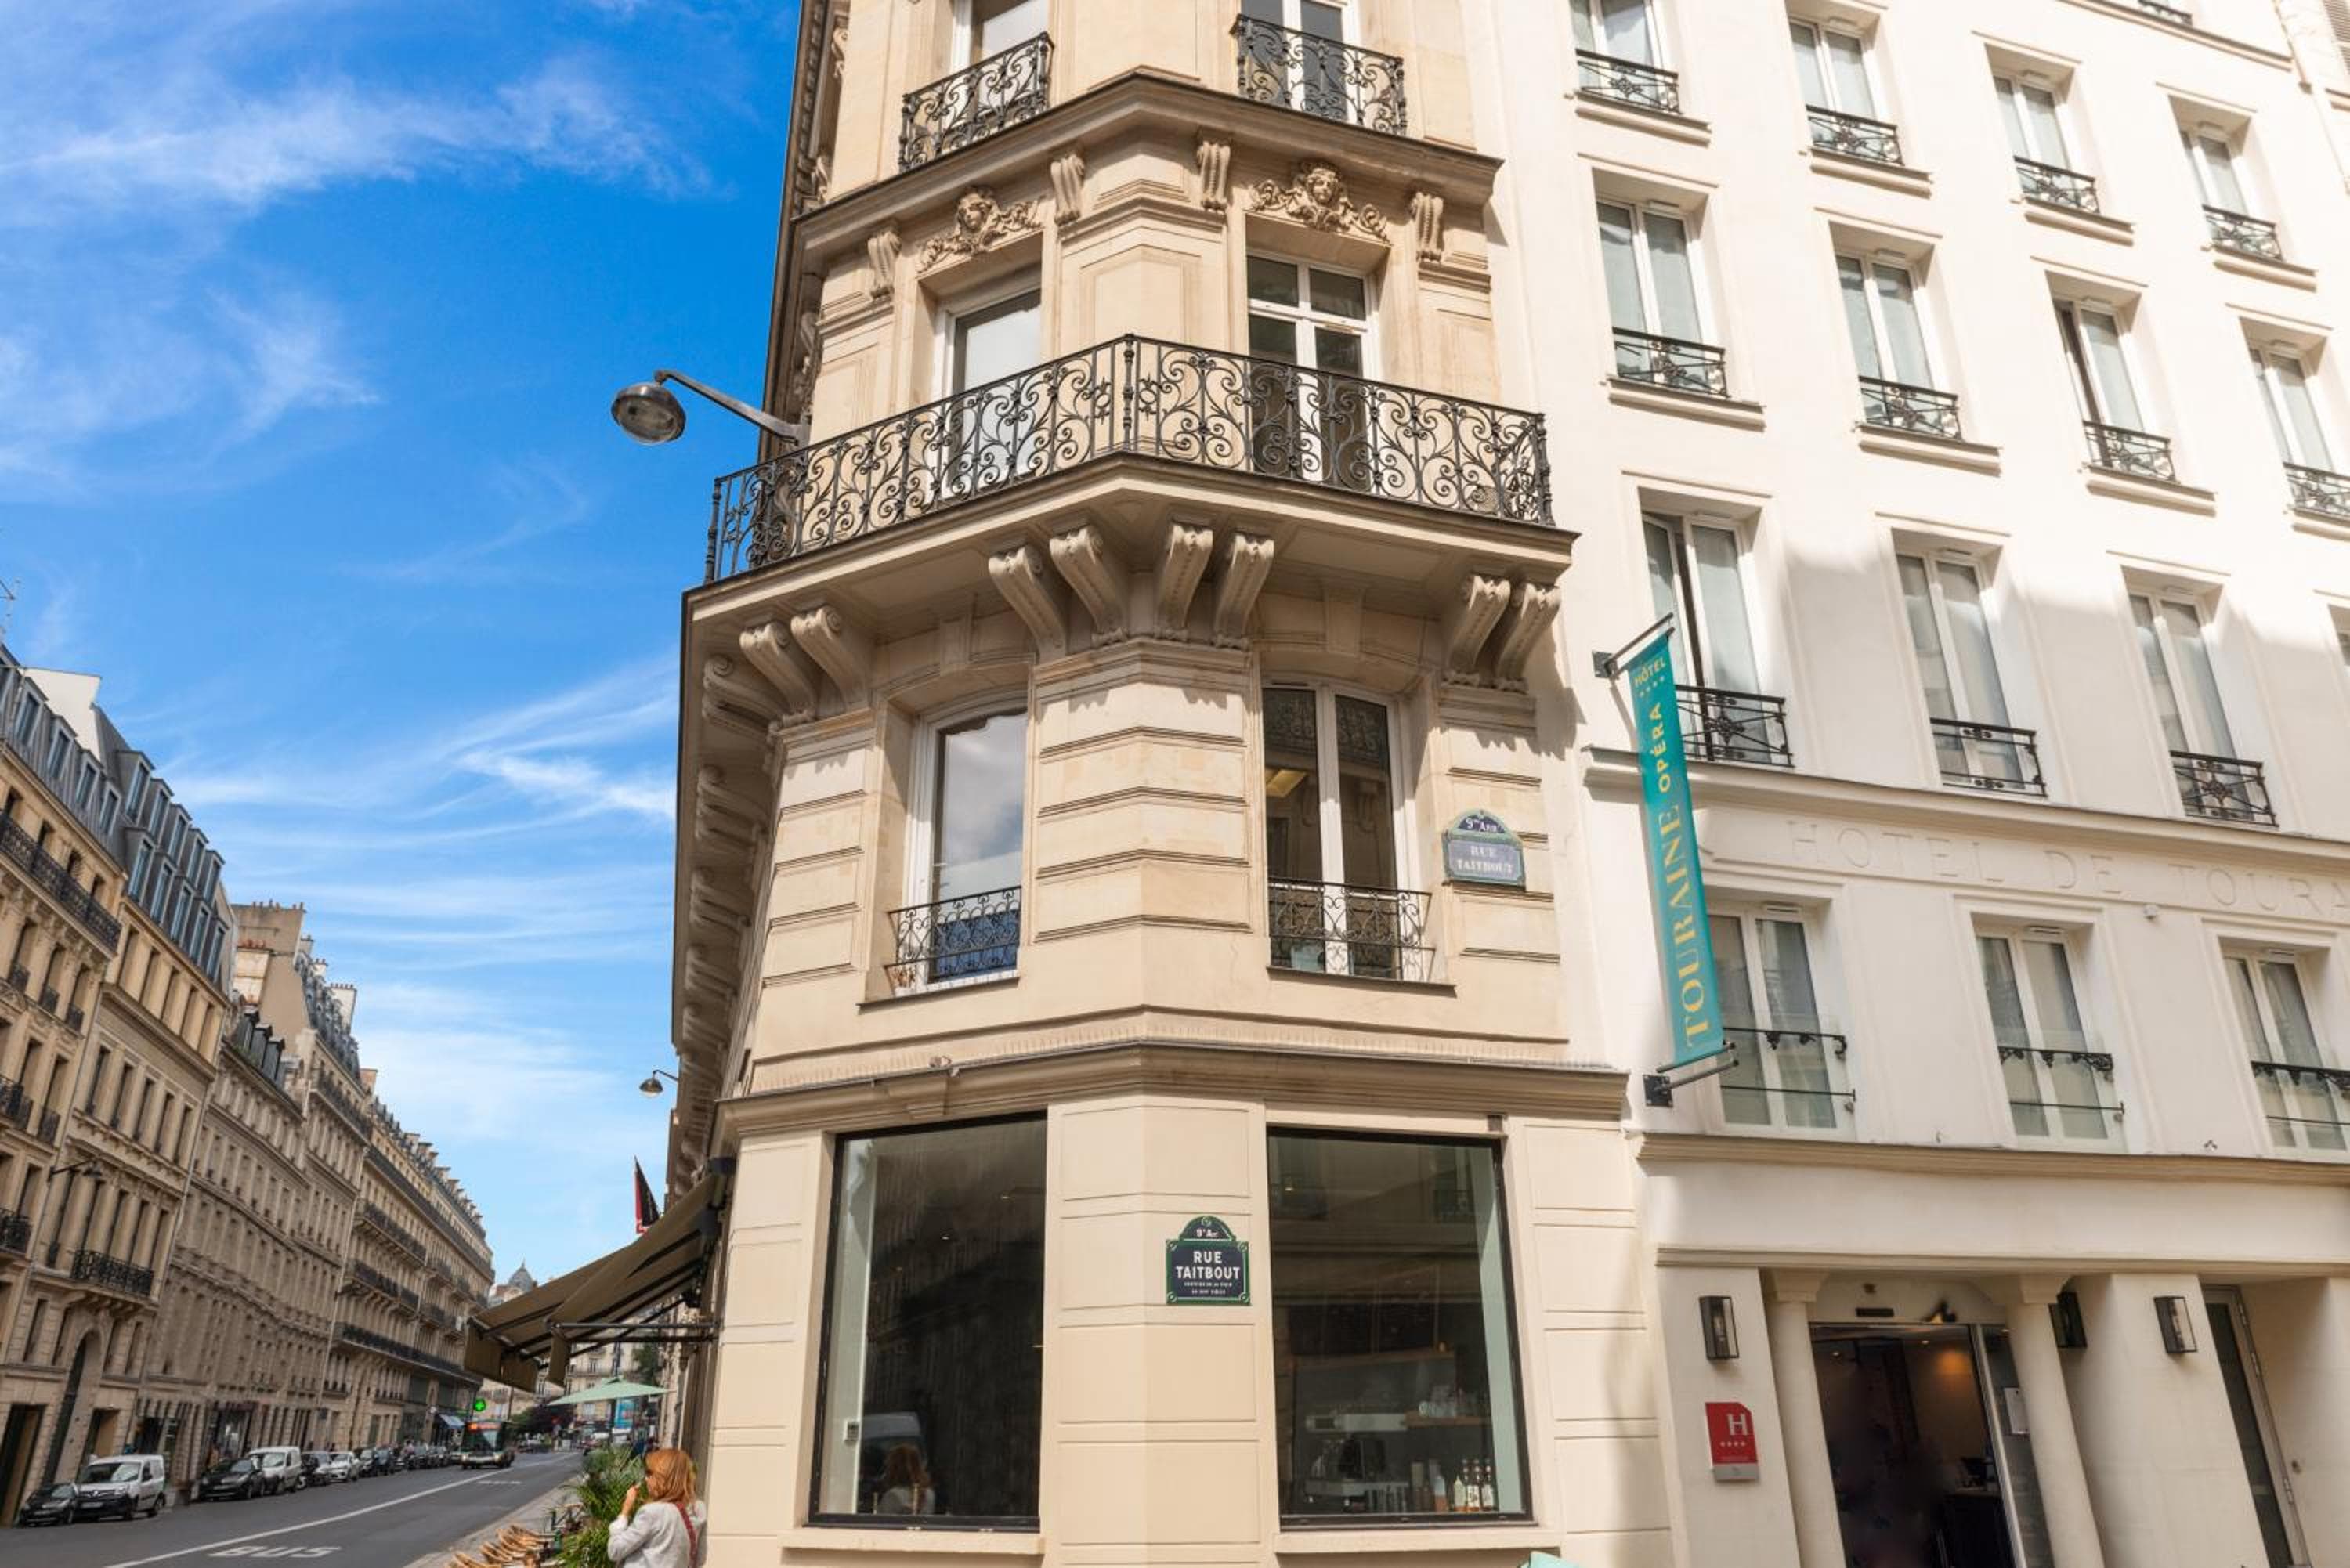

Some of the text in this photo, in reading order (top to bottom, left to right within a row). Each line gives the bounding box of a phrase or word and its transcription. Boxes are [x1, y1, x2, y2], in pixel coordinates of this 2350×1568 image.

[1633, 656, 1666, 687] HÔTEL
[1470, 845, 1495, 858] RUE
[1785, 820, 2004, 883] HOTEL
[2043, 850, 2122, 894] DE
[1649, 702, 1710, 1048] TOURAINE OPÉRA
[1193, 1251, 1222, 1263] RUE
[1176, 1266, 1240, 1279] TAITBOUT
[1726, 1413, 1748, 1436] H
[206, 1546, 342, 1558] BUS
